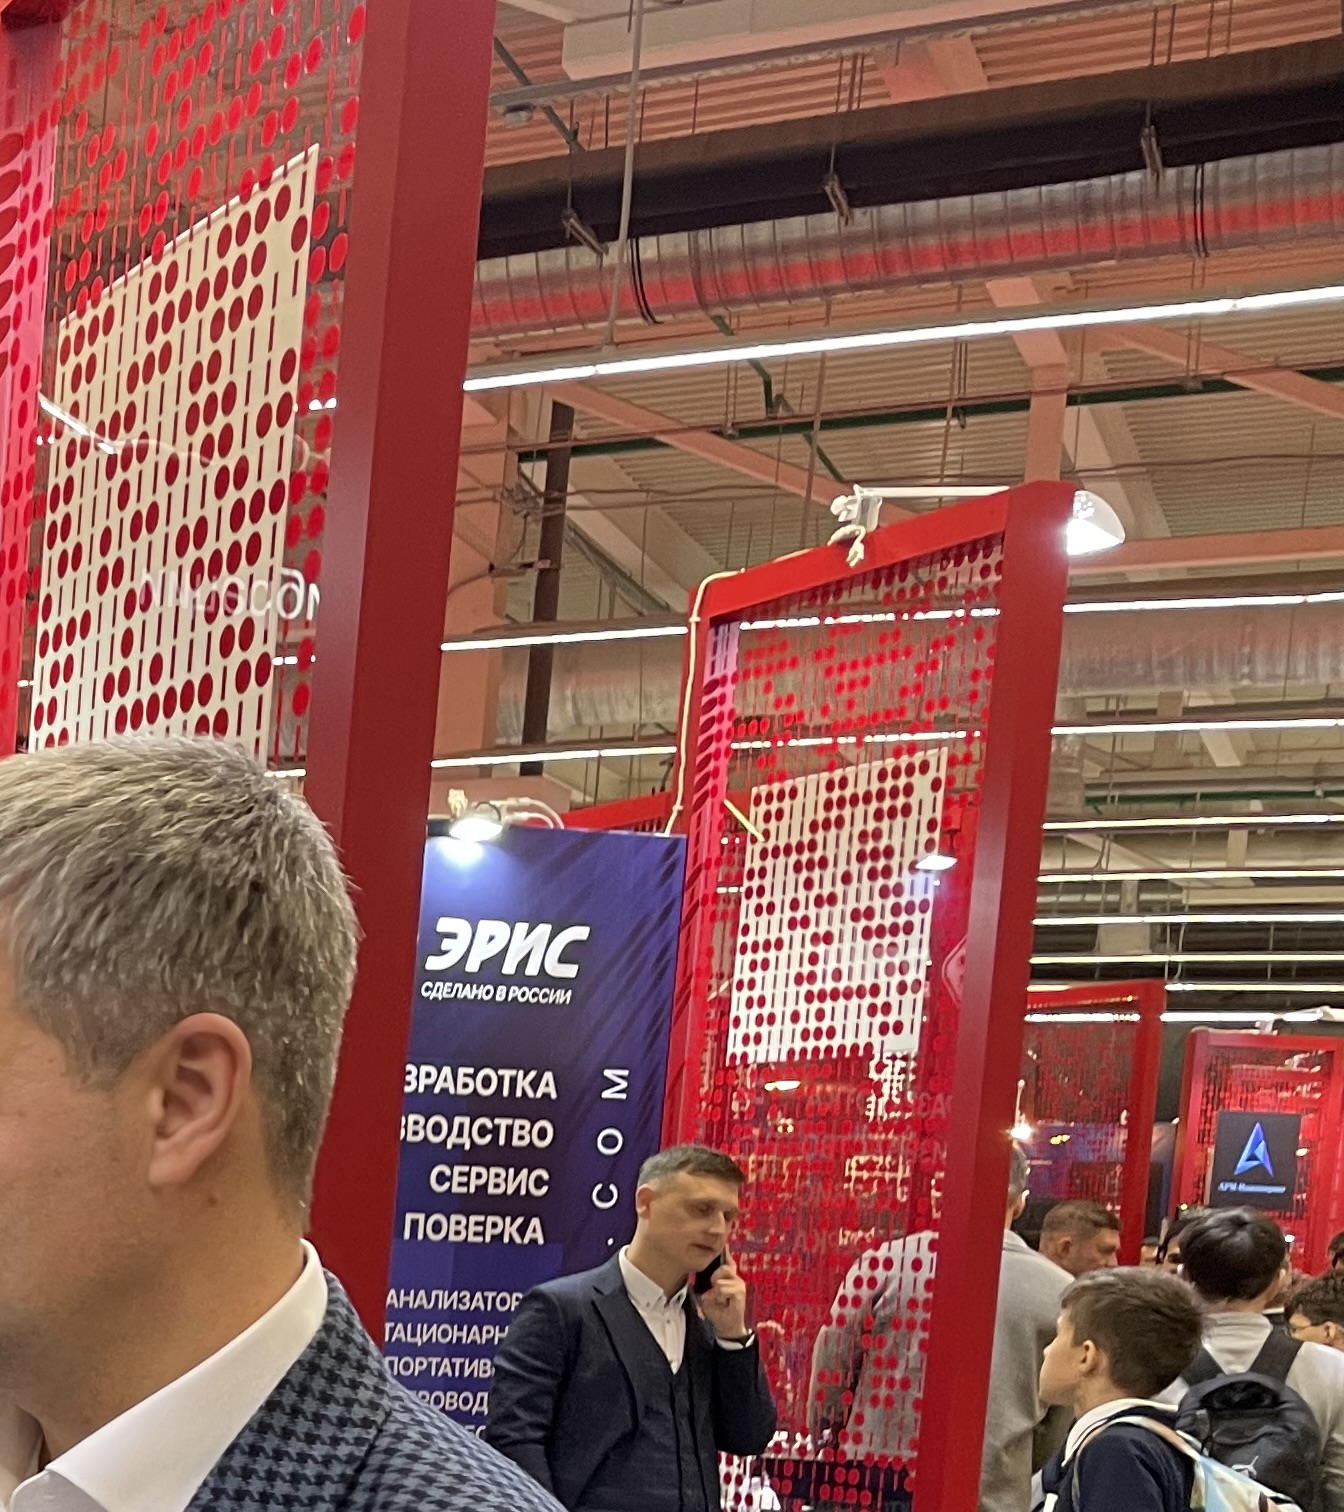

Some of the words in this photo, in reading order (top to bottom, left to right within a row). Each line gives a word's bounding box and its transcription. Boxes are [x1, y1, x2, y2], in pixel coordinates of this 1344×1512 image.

[425, 917, 590, 978] ЭРИС
[421, 981, 494, 1001] СДЕЛАНО
[496, 985, 506, 1001] В
[509, 986, 572, 1004] РОССИИ
[430, 1163, 550, 1197] СЕРВИС
[403, 1212, 545, 1246] ПОВЕРКА
[384, 1356, 495, 1379] ПОРТАТИВ
